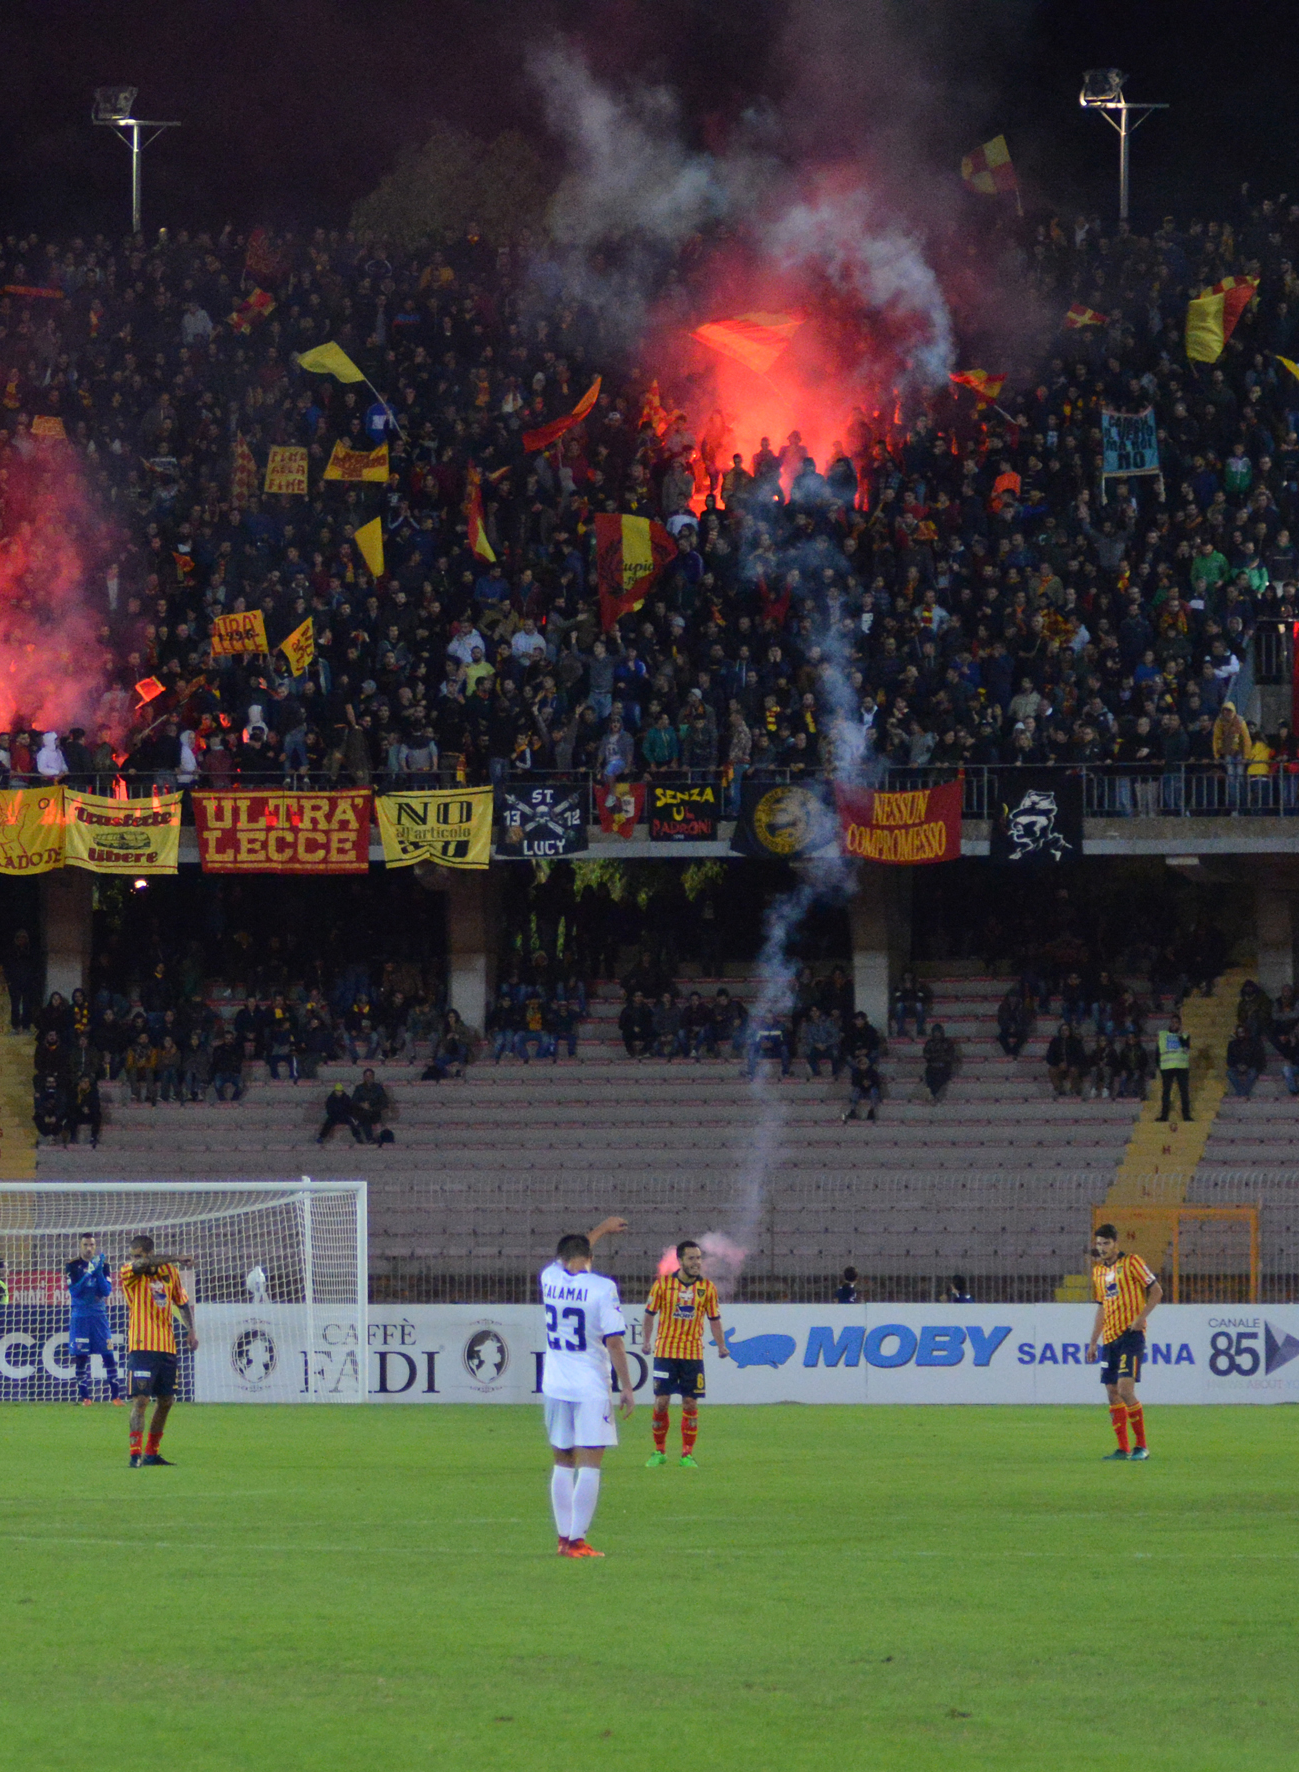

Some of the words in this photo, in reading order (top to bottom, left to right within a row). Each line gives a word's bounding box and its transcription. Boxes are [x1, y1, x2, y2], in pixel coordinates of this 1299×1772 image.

[1117, 451, 1146, 469] NO
[655, 786, 715, 807] SENZA
[872, 791, 931, 825] NESSUN
[203, 797, 364, 830] ULTRA'
[395, 801, 473, 826] NO
[504, 810, 521, 826] 13
[564, 809, 581, 826] 12
[203, 830, 358, 862] LECCE
[523, 839, 566, 856] LUCY
[847, 821, 947, 861] COMPROMESSO
[322, 1318, 417, 1345] CAFFÈ
[545, 1304, 588, 1351] 23
[1208, 1318, 1260, 1328] CANALE
[803, 1323, 1013, 1368] MOBY
[1017, 1343, 1196, 1365] SARDNA
[1209, 1331, 1261, 1377] 85
[300, 1350, 441, 1394] FADI
